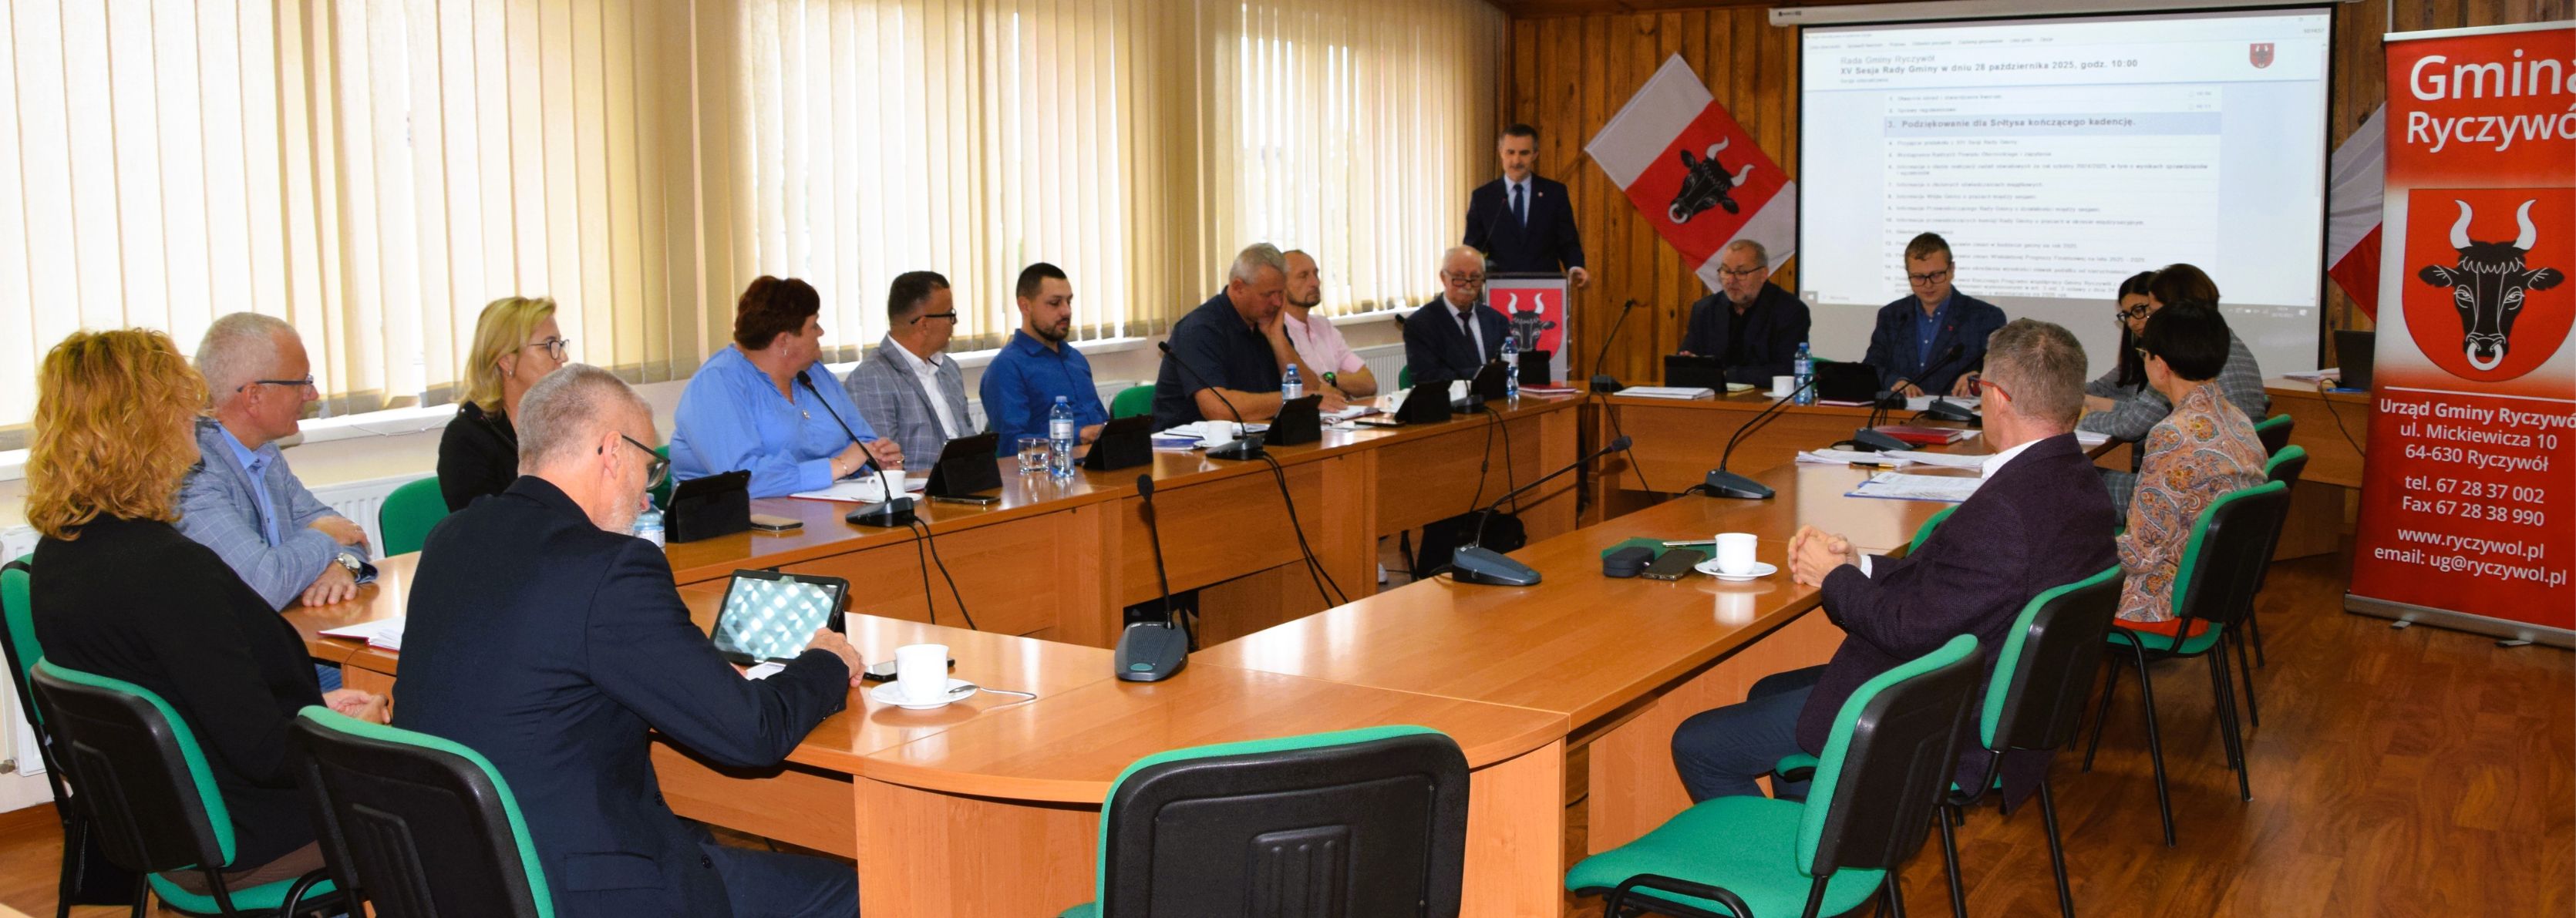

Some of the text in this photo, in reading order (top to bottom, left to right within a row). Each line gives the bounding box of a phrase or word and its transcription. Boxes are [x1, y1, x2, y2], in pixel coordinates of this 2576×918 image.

[1840, 56, 1863, 65] Rada
[1866, 56, 1891, 65] Gminy
[1856, 66, 1879, 76] Sesja
[1883, 66, 1905, 74] Rady
[1908, 65, 1938, 74] Gminy
[2112, 59, 2138, 68] 10:00
[1901, 119, 1970, 129] Podziękowanie
[1973, 119, 1988, 127] dla
[2380, 398, 2430, 419] Urząd
[2435, 402, 2494, 425] Gminy
[2400, 422, 2557, 450] ul. Mickiewicza 10
[2405, 444, 2549, 472] 64-630 Ryczywół
[2405, 476, 2544, 504] tel. 67 28 37 002
[2403, 496, 2544, 526] Fax 67 28 38 990
[2397, 529, 2544, 562] www.ryczywol.pl
[2374, 546, 2567, 587] email: ug@ryczywol.pl
